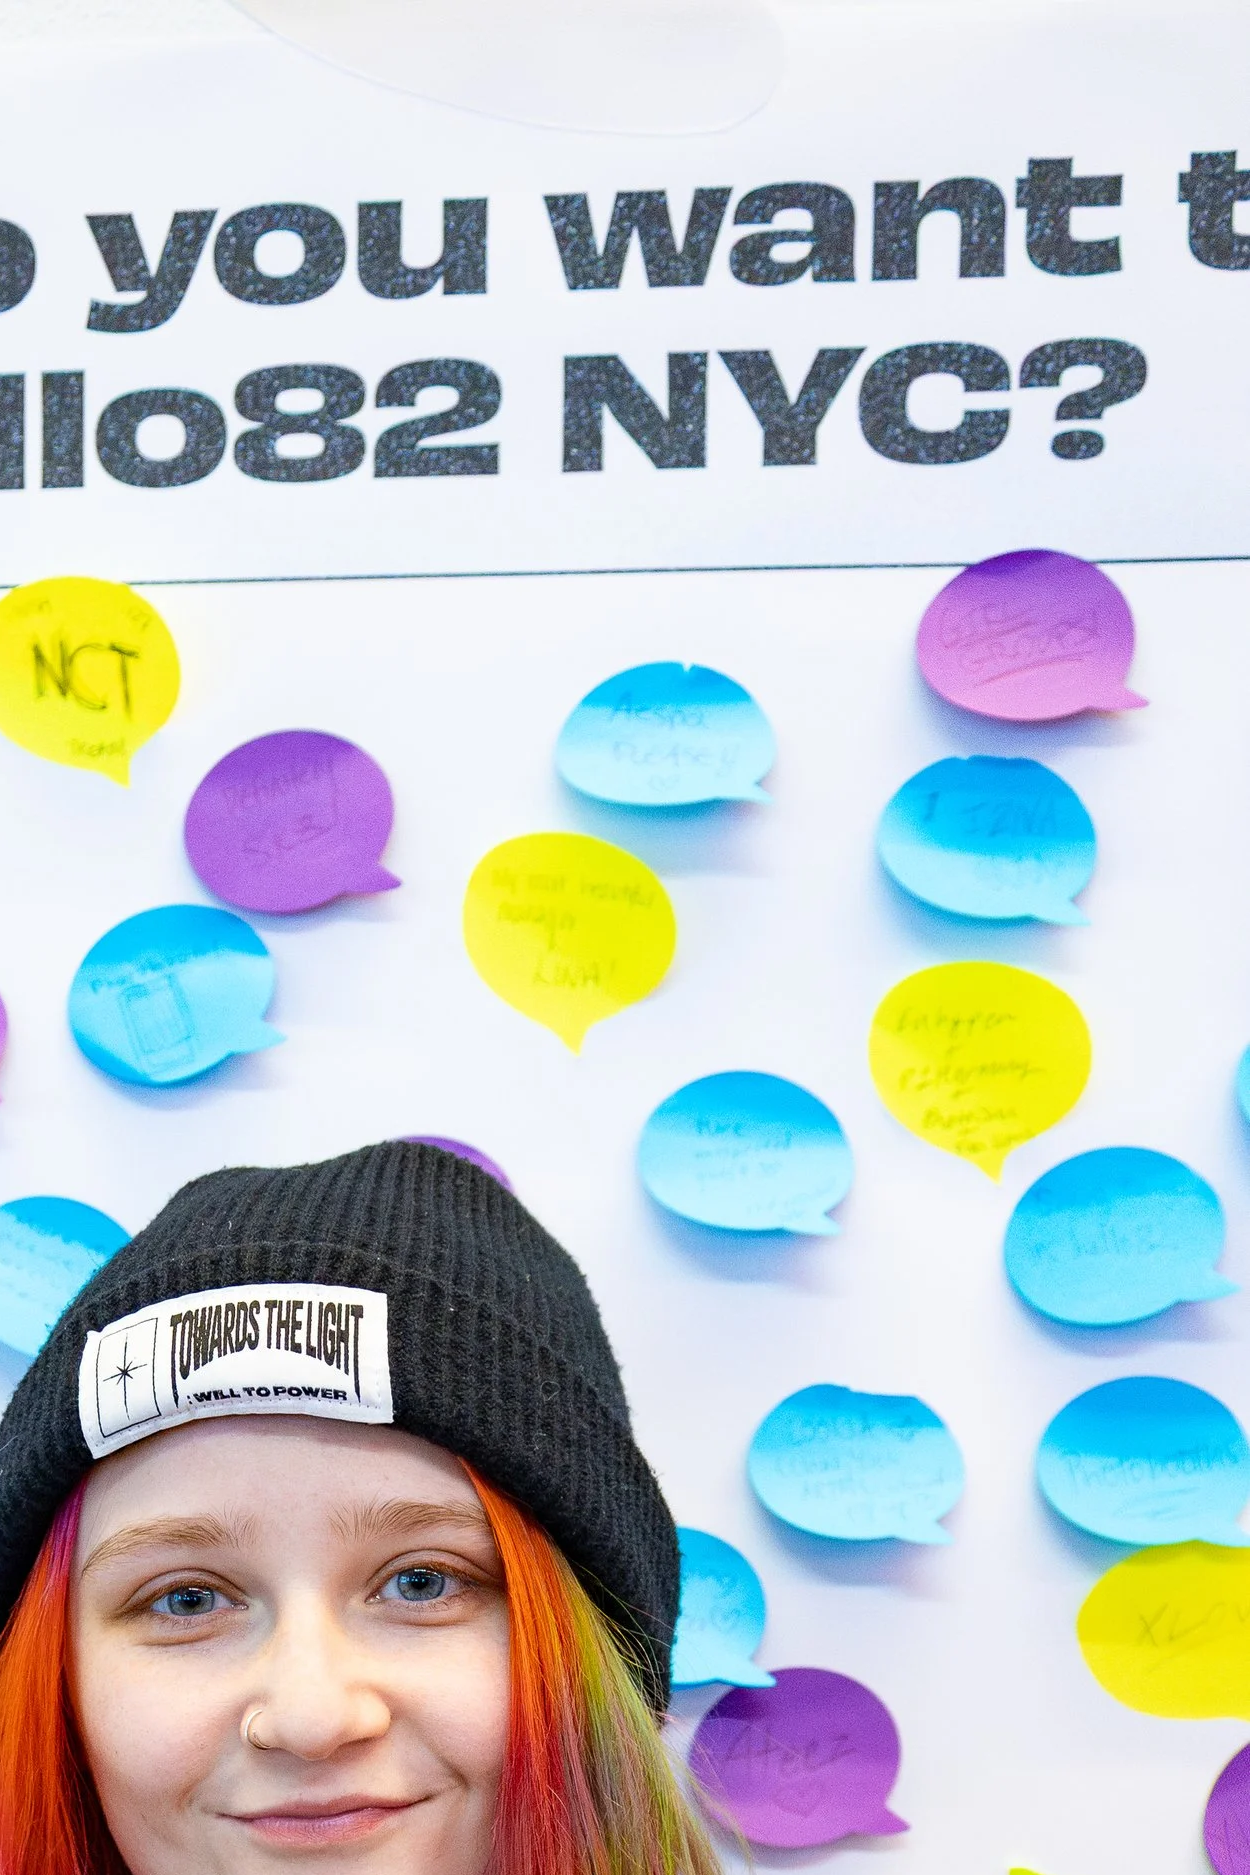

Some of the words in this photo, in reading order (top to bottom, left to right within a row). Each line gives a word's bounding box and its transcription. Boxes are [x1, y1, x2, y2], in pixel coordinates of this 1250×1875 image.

[86, 199, 487, 333] you
[544, 158, 1123, 290] want
[562, 338, 1147, 472] NYC?
[31, 634, 140, 719] NCT
[170, 1300, 261, 1408] TOWARDS
[264, 1299, 304, 1354] THE
[305, 1300, 364, 1403] LIGHT
[193, 1387, 240, 1404] WILL
[242, 1386, 271, 1398] TO
[272, 1385, 348, 1401] POWER
